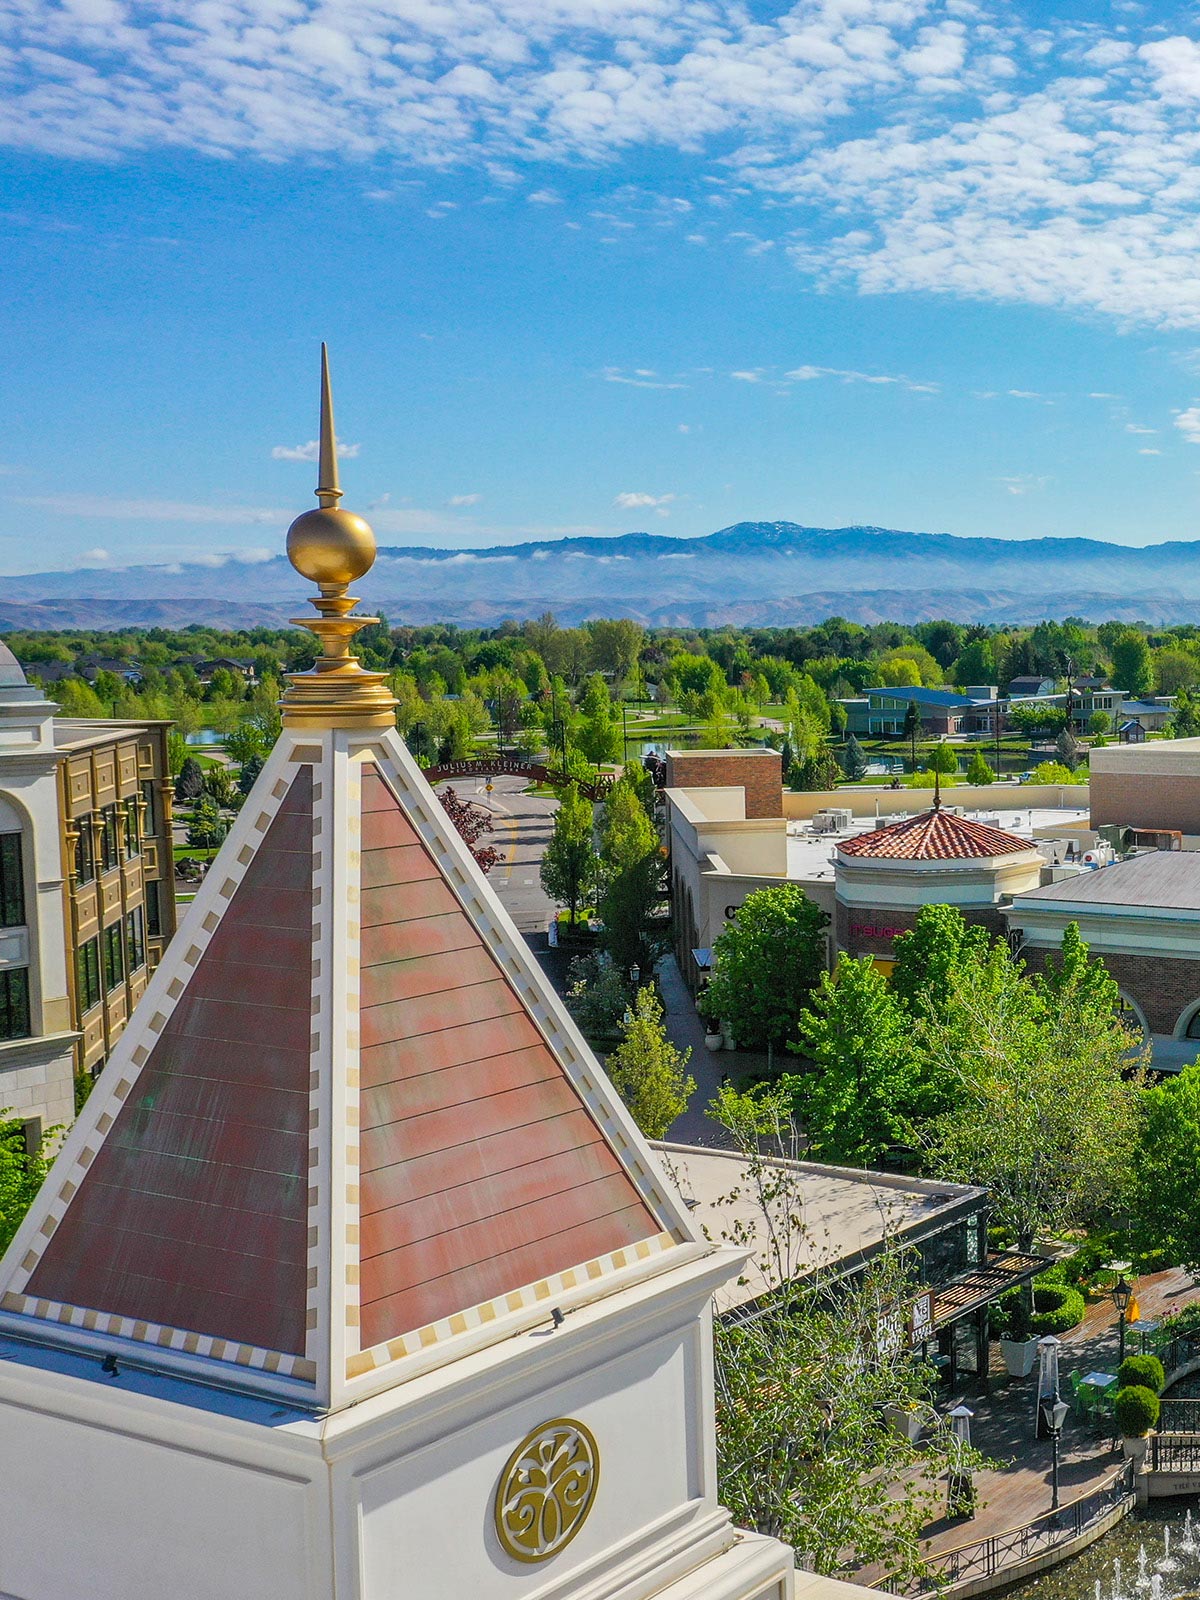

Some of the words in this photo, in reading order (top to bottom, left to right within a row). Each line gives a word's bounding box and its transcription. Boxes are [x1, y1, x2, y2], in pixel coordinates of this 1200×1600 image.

[437, 762, 472, 773] JULIUS
[476, 760, 486, 768] M.
[490, 760, 532, 770] KLEINER
